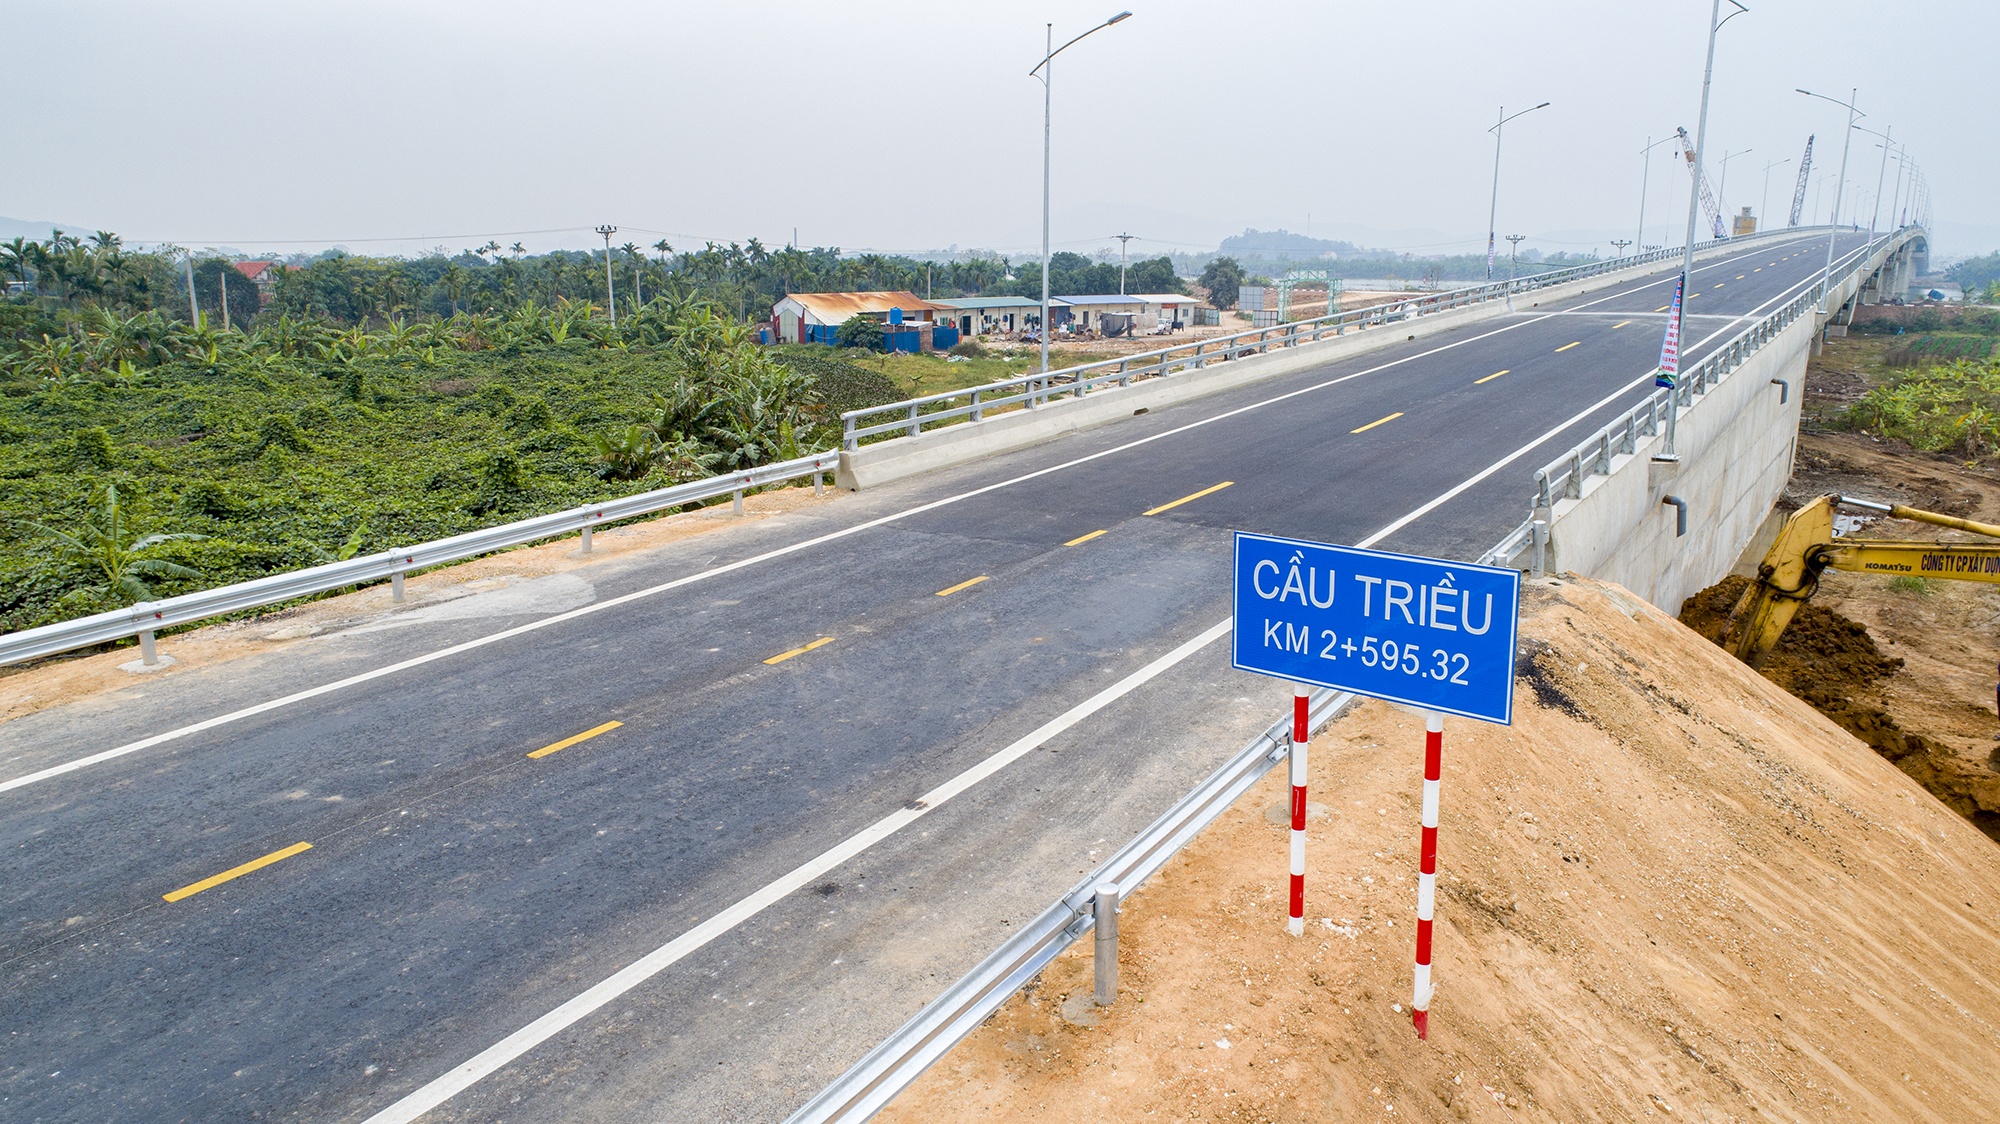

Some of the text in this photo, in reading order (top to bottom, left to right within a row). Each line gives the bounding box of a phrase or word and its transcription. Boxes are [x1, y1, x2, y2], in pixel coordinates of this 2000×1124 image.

[1865, 563, 1912, 572] KOMATSU
[1945, 554, 1955, 571] TY
[1956, 555, 1968, 572] CP
[1253, 550, 1492, 635] CẦU TRIỀU
[1264, 618, 1470, 686] KM 2+595.32
